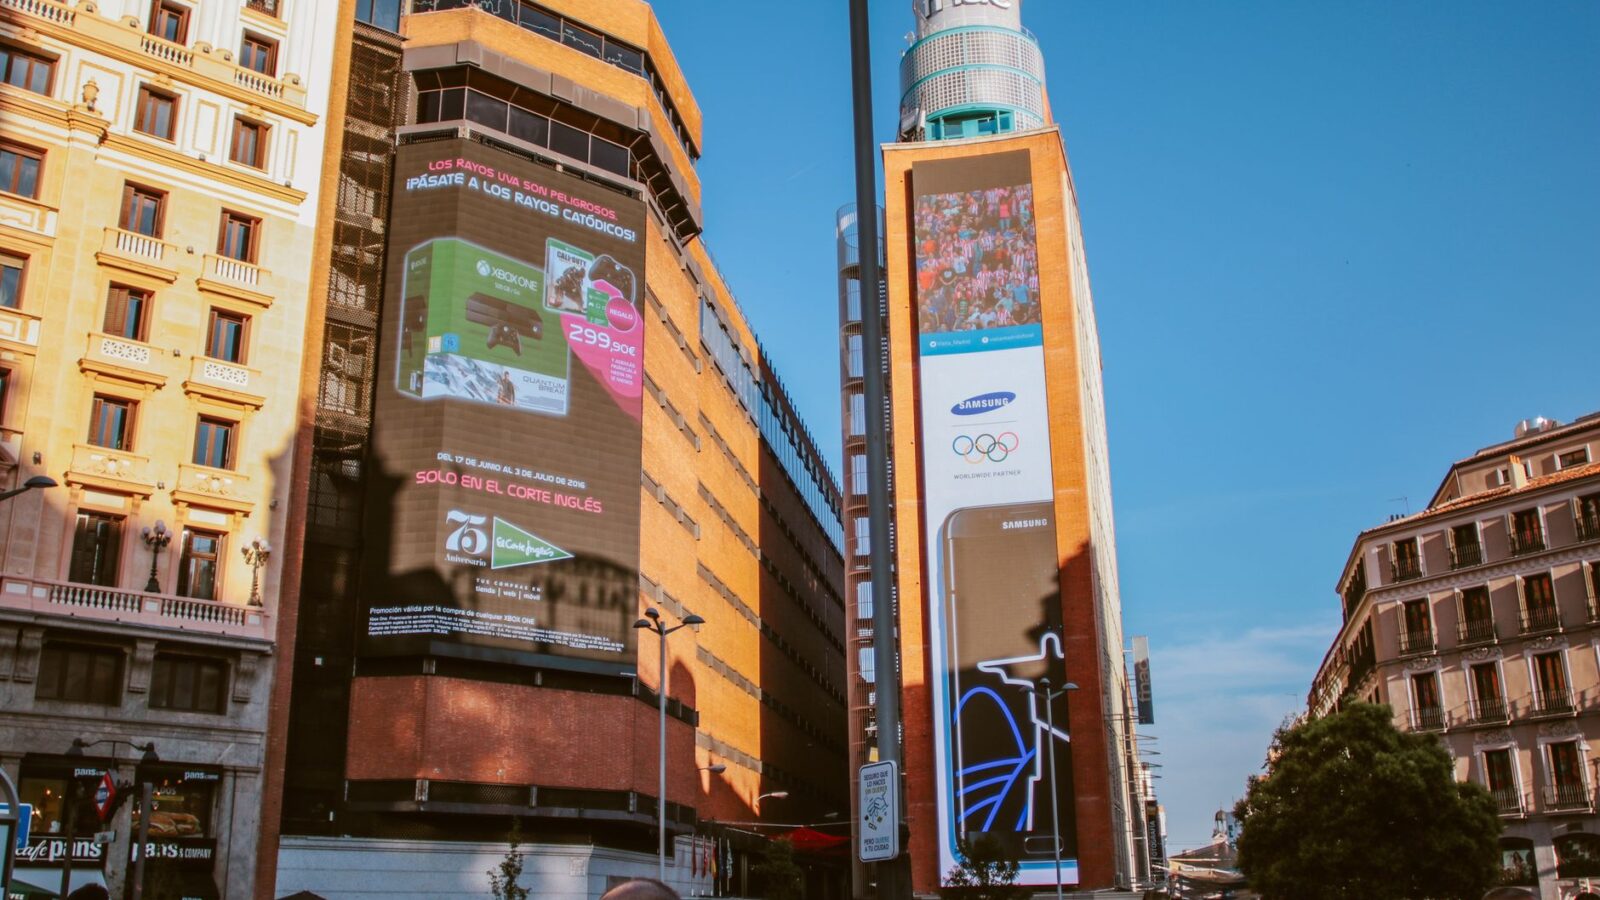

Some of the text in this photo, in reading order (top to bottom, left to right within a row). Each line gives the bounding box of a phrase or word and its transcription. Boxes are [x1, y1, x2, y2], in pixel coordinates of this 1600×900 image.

[428, 158, 618, 221] LOS RAYOS UVA SON PELIGROSOS.
[406, 173, 636, 242] ¡PÁSATE A LOS RAYOS CATÓDICOS!
[491, 266, 518, 284] XBOX
[517, 276, 538, 292] ONE
[522, 375, 566, 389] QUANTUM
[538, 384, 565, 395] BREAK
[959, 398, 1009, 410] SAMSUNG
[437, 452, 453, 462] DEL
[455, 455, 464, 463] 17
[465, 458, 476, 467] DE
[477, 461, 501, 472] JUNIO
[502, 465, 513, 475] AL
[521, 469, 532, 477] DE
[533, 472, 555, 482] JULIO
[555, 476, 566, 485] DE
[567, 479, 586, 489] 2016
[954, 470, 1022, 480] WORLDWIDE PARTNER
[415, 470, 602, 514] SOLO EN EL CORTE INGLÉS
[1002, 518, 1048, 530] SAMSUNG
[445, 510, 488, 555] 75
[496, 536, 505, 548] El
[505, 538, 526, 552] Corte
[444, 553, 487, 567] Aniversario
[475, 585, 496, 594] tienda
[503, 590, 517, 598] web
[369, 606, 402, 614] Promoción
[403, 605, 421, 613] válida
[442, 608, 466, 616] compra
[466, 609, 475, 617] de
[503, 614, 521, 623] XBOX
[521, 617, 535, 625] ONE
[74, 768, 97, 778] pans
[184, 770, 205, 780] pans
[185, 848, 211, 858] COMPANY
